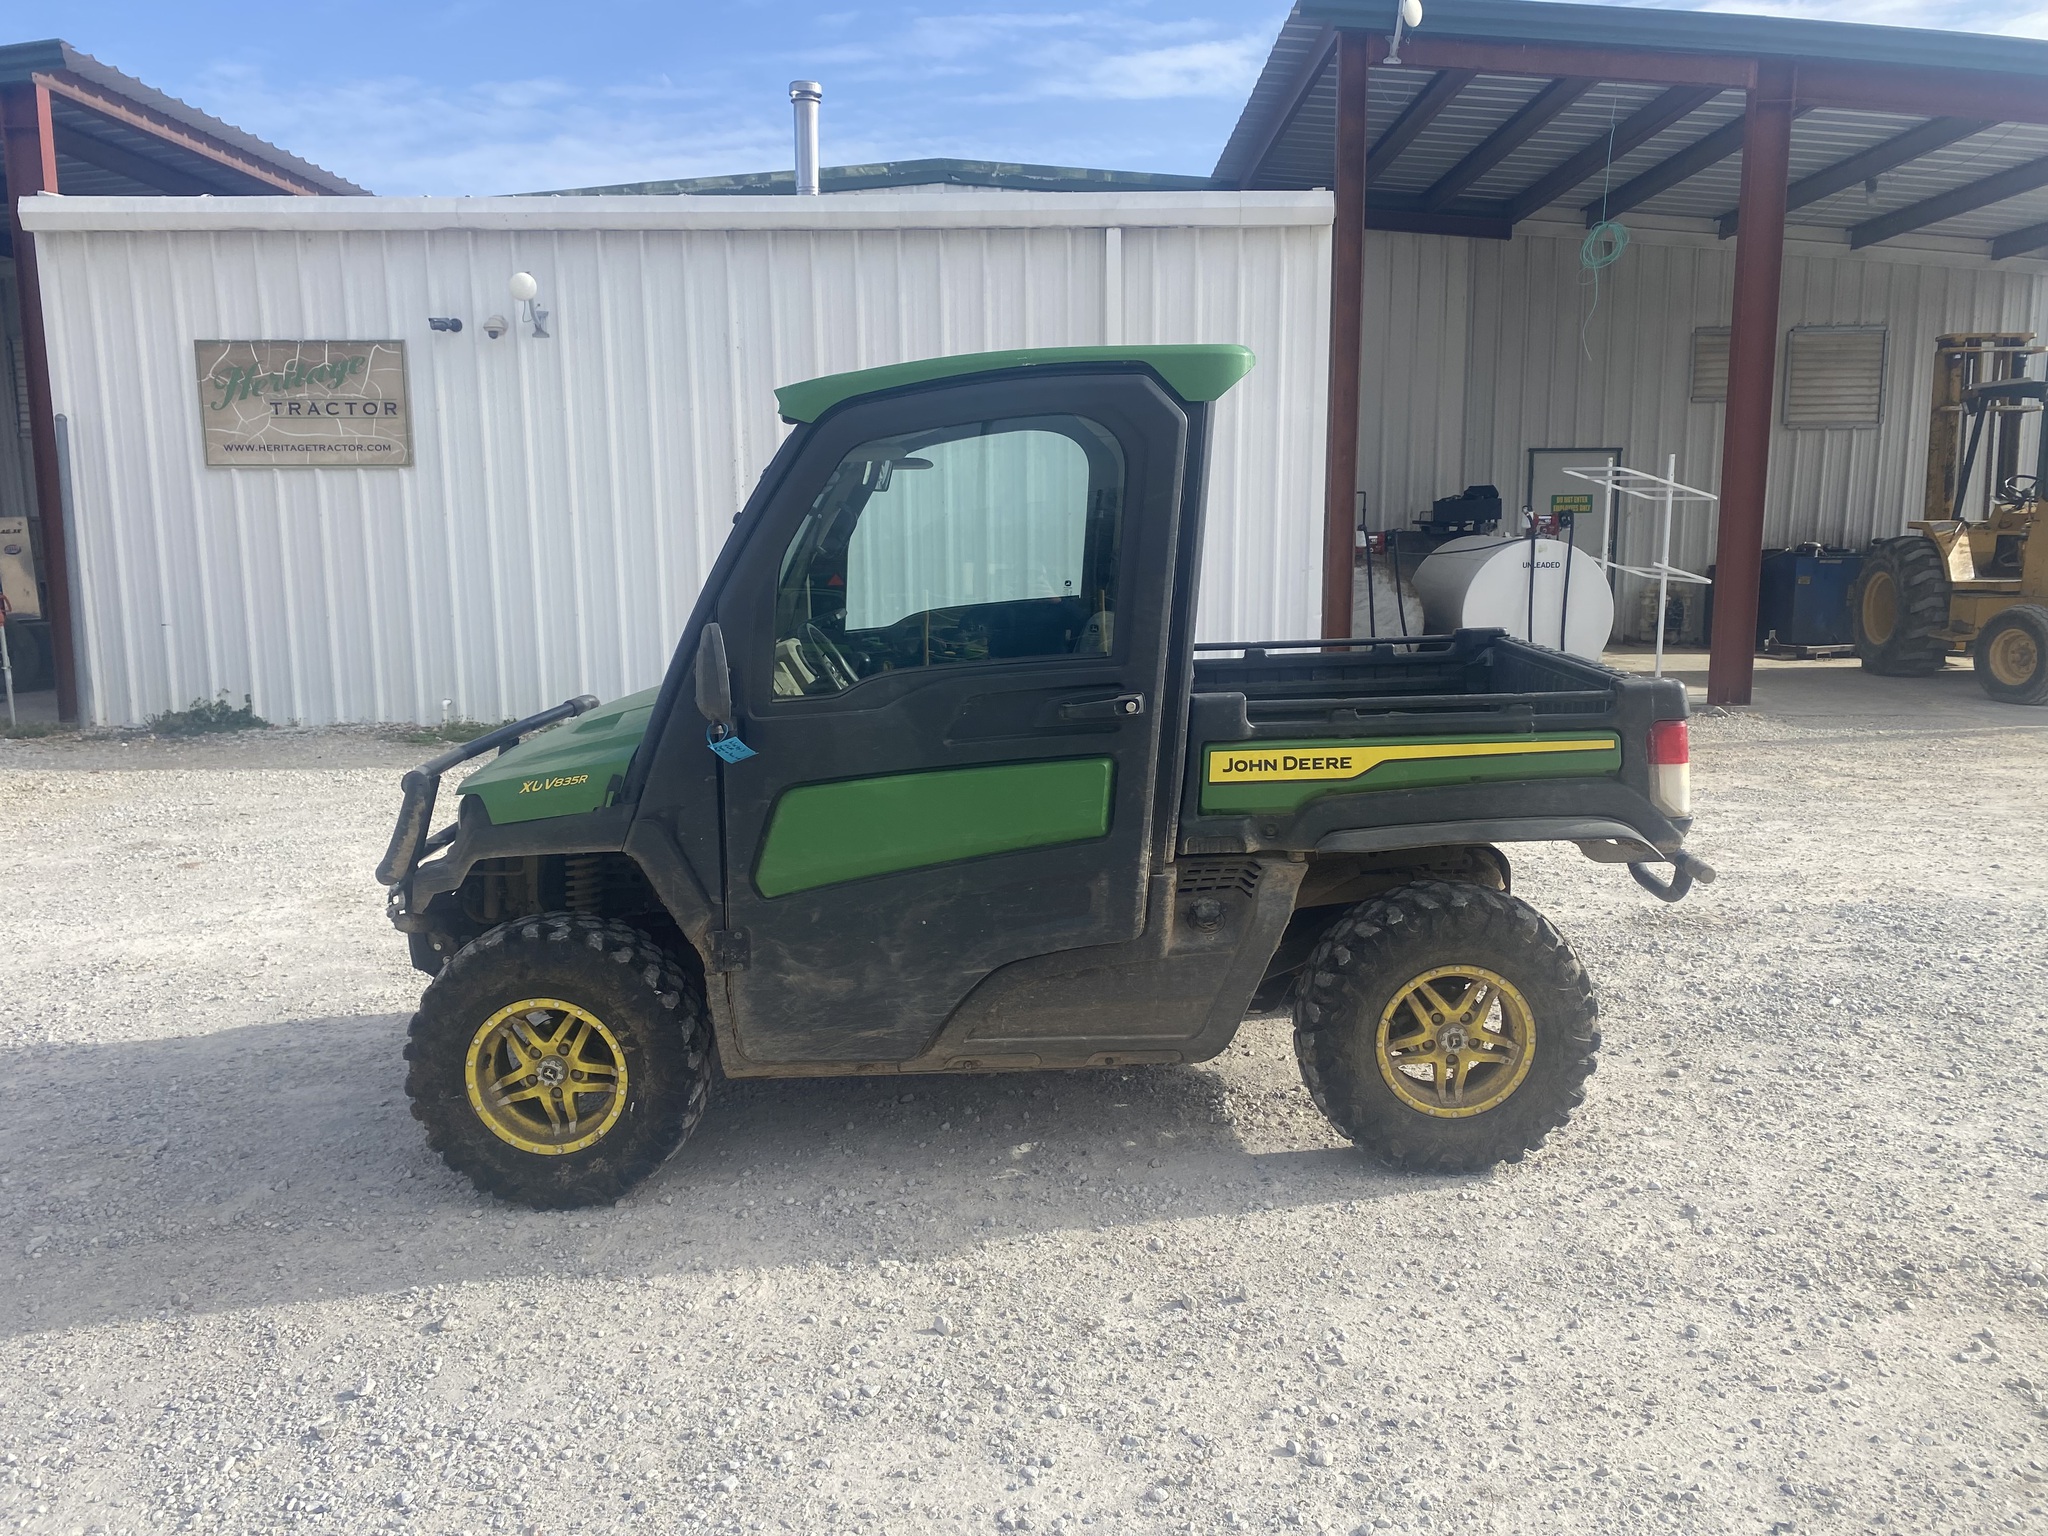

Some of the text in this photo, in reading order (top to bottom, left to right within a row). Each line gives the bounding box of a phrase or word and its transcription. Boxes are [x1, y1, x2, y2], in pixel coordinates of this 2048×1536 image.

[211, 355, 366, 411] Heritage
[270, 402, 398, 416] TRACTOR
[223, 444, 392, 452] WWW.HERITAGETRACTOR.COM
[1222, 756, 1352, 773] JOHN DEERE
[519, 774, 589, 794] XUV835R
